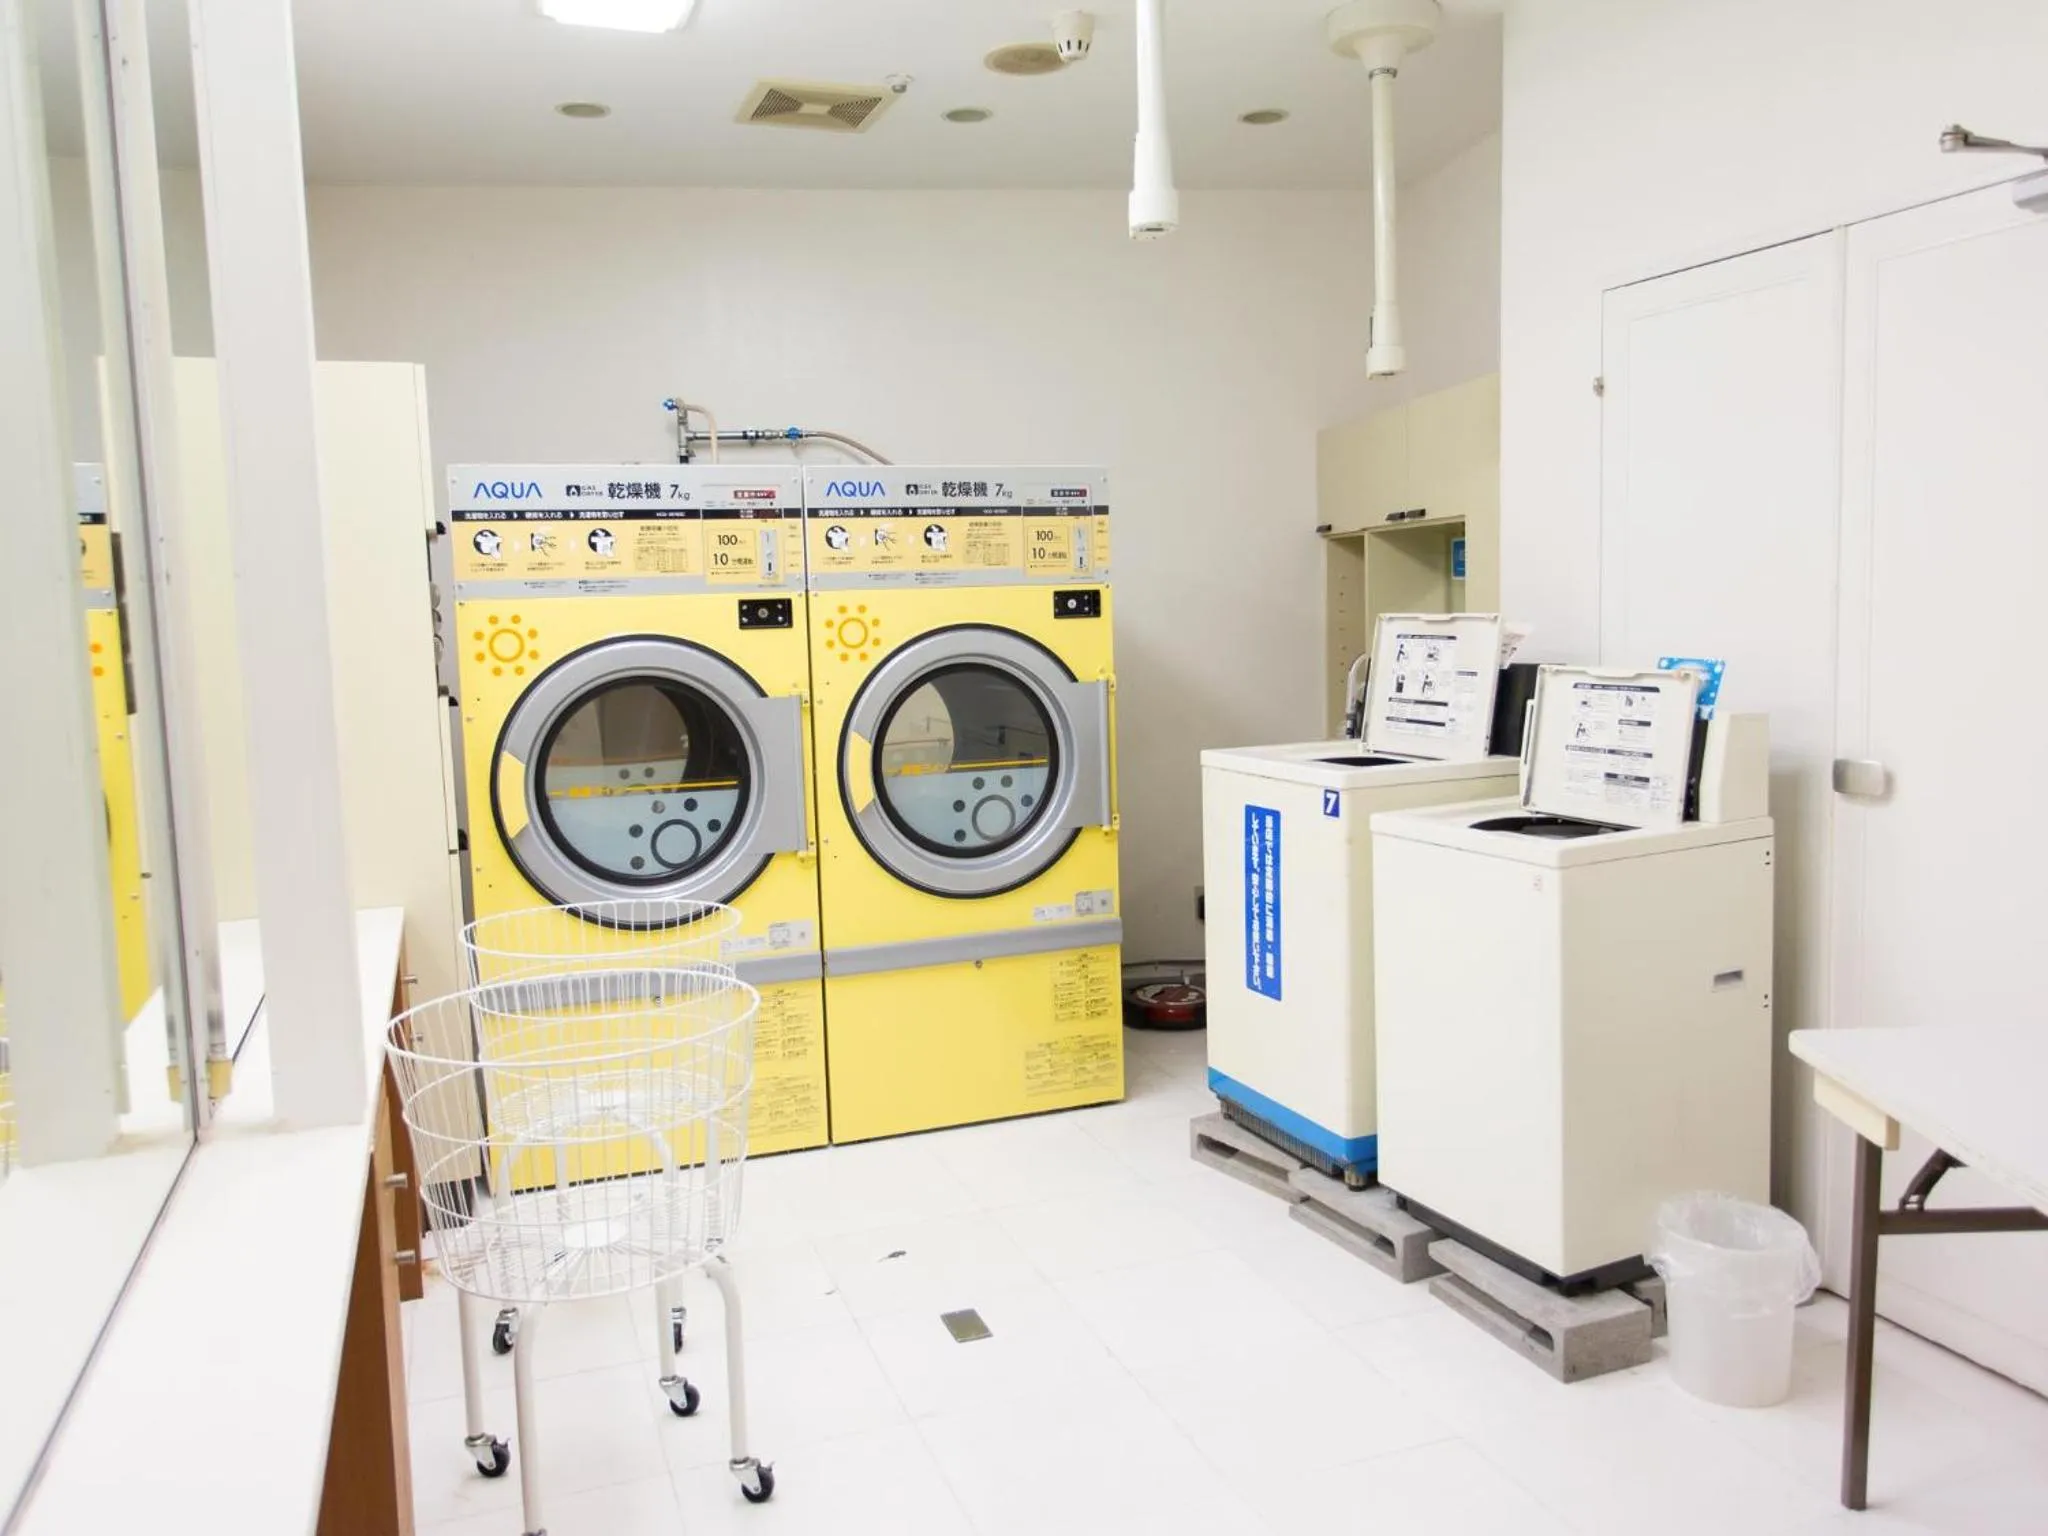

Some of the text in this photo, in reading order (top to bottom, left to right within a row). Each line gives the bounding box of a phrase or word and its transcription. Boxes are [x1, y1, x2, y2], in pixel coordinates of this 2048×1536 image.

[473, 481, 542, 499] AQUA
[607, 482, 661, 499] 乾燥機
[825, 481, 886, 497] AQUA
[942, 481, 987, 498] 乾燥機
[717, 534, 738, 546] 100
[1036, 530, 1054, 541] 100
[713, 553, 729, 566] 10
[1032, 547, 1046, 559] 10
[1325, 793, 1338, 814] 7
